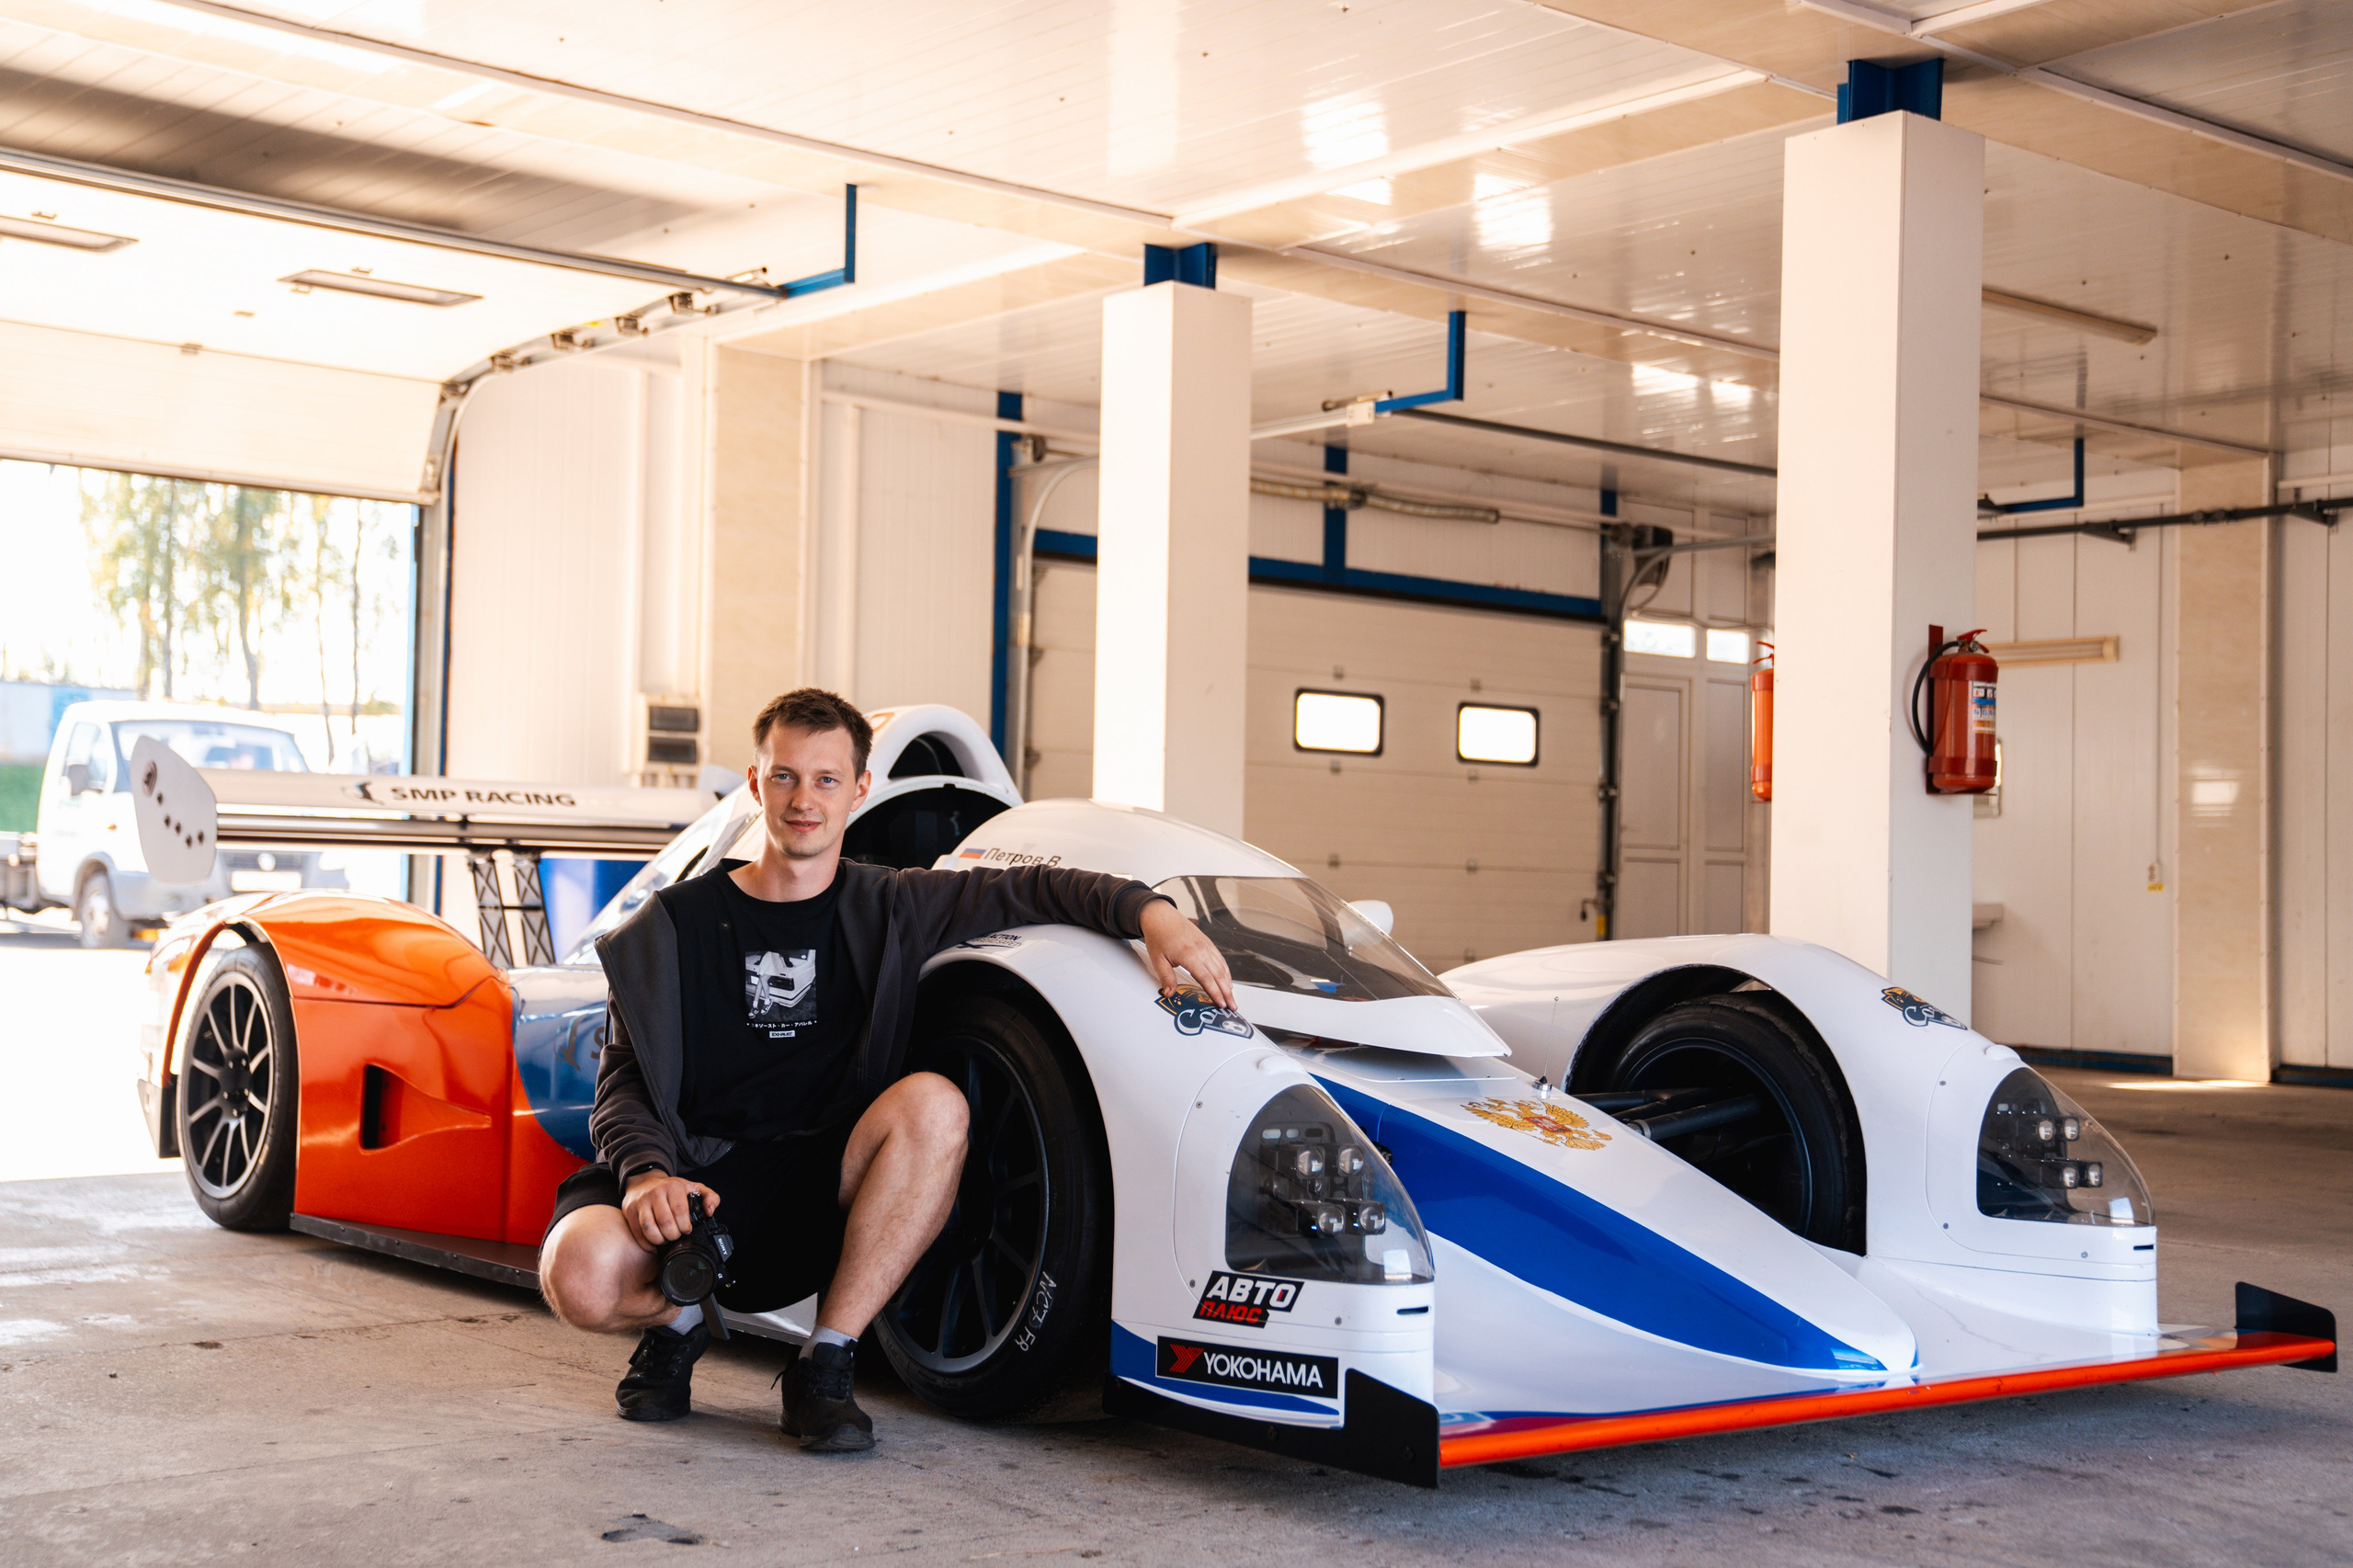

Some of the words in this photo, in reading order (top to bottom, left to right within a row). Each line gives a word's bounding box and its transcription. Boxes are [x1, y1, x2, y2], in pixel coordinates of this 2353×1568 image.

[391, 787, 456, 802] SMP
[464, 790, 577, 807] RACING
[984, 847, 1044, 866] Петров
[718, 1237, 728, 1256] SONY
[1206, 1276, 1297, 1309] АВТО
[1199, 1301, 1263, 1324] ПЛЮС
[1014, 1325, 1036, 1351] FR
[1203, 1351, 1324, 1389] YOKOHAMA
